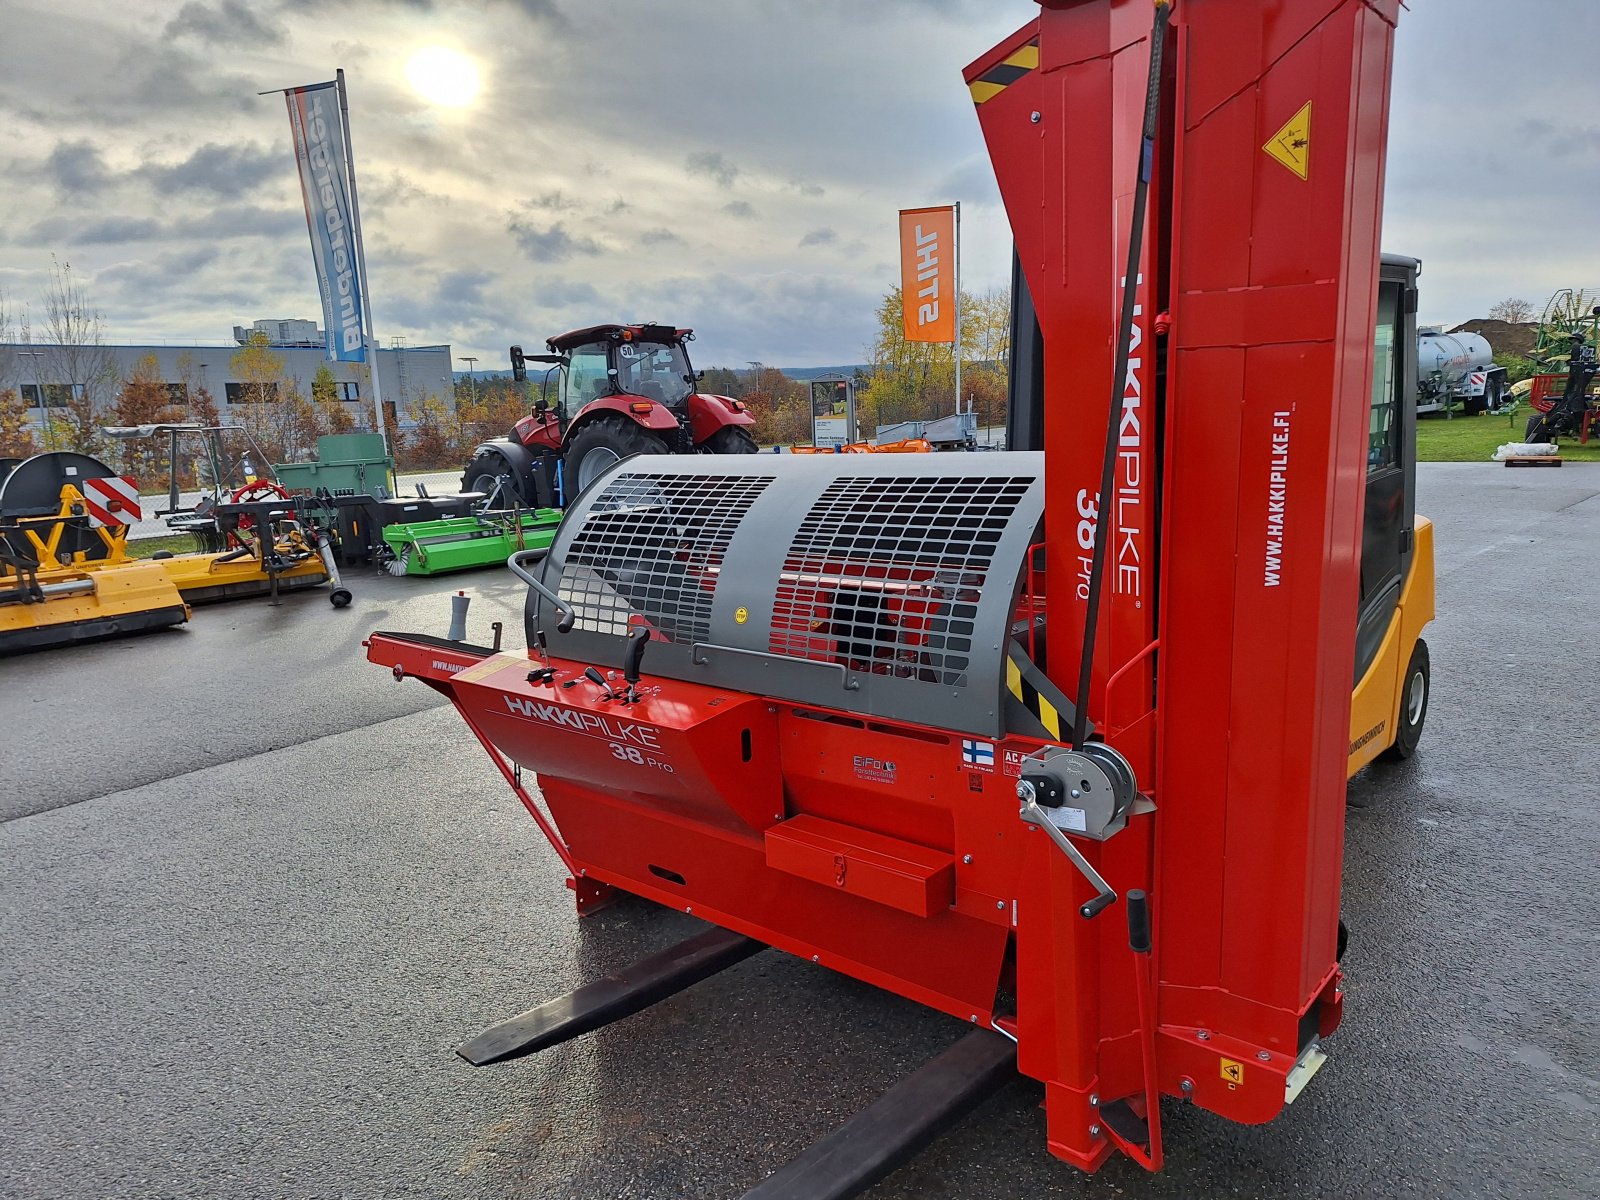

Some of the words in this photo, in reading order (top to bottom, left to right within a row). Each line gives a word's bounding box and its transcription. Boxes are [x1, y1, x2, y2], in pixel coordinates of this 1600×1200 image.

[621, 346, 633, 357] 50
[1076, 488, 1102, 549] 38
[1264, 410, 1291, 587] WWW.HAKKIPILKE.FI
[504, 694, 661, 748] HAKKIPILKE
[609, 742, 645, 765] 38
[647, 756, 673, 773] Pro
[1005, 751, 1018, 763] AC
